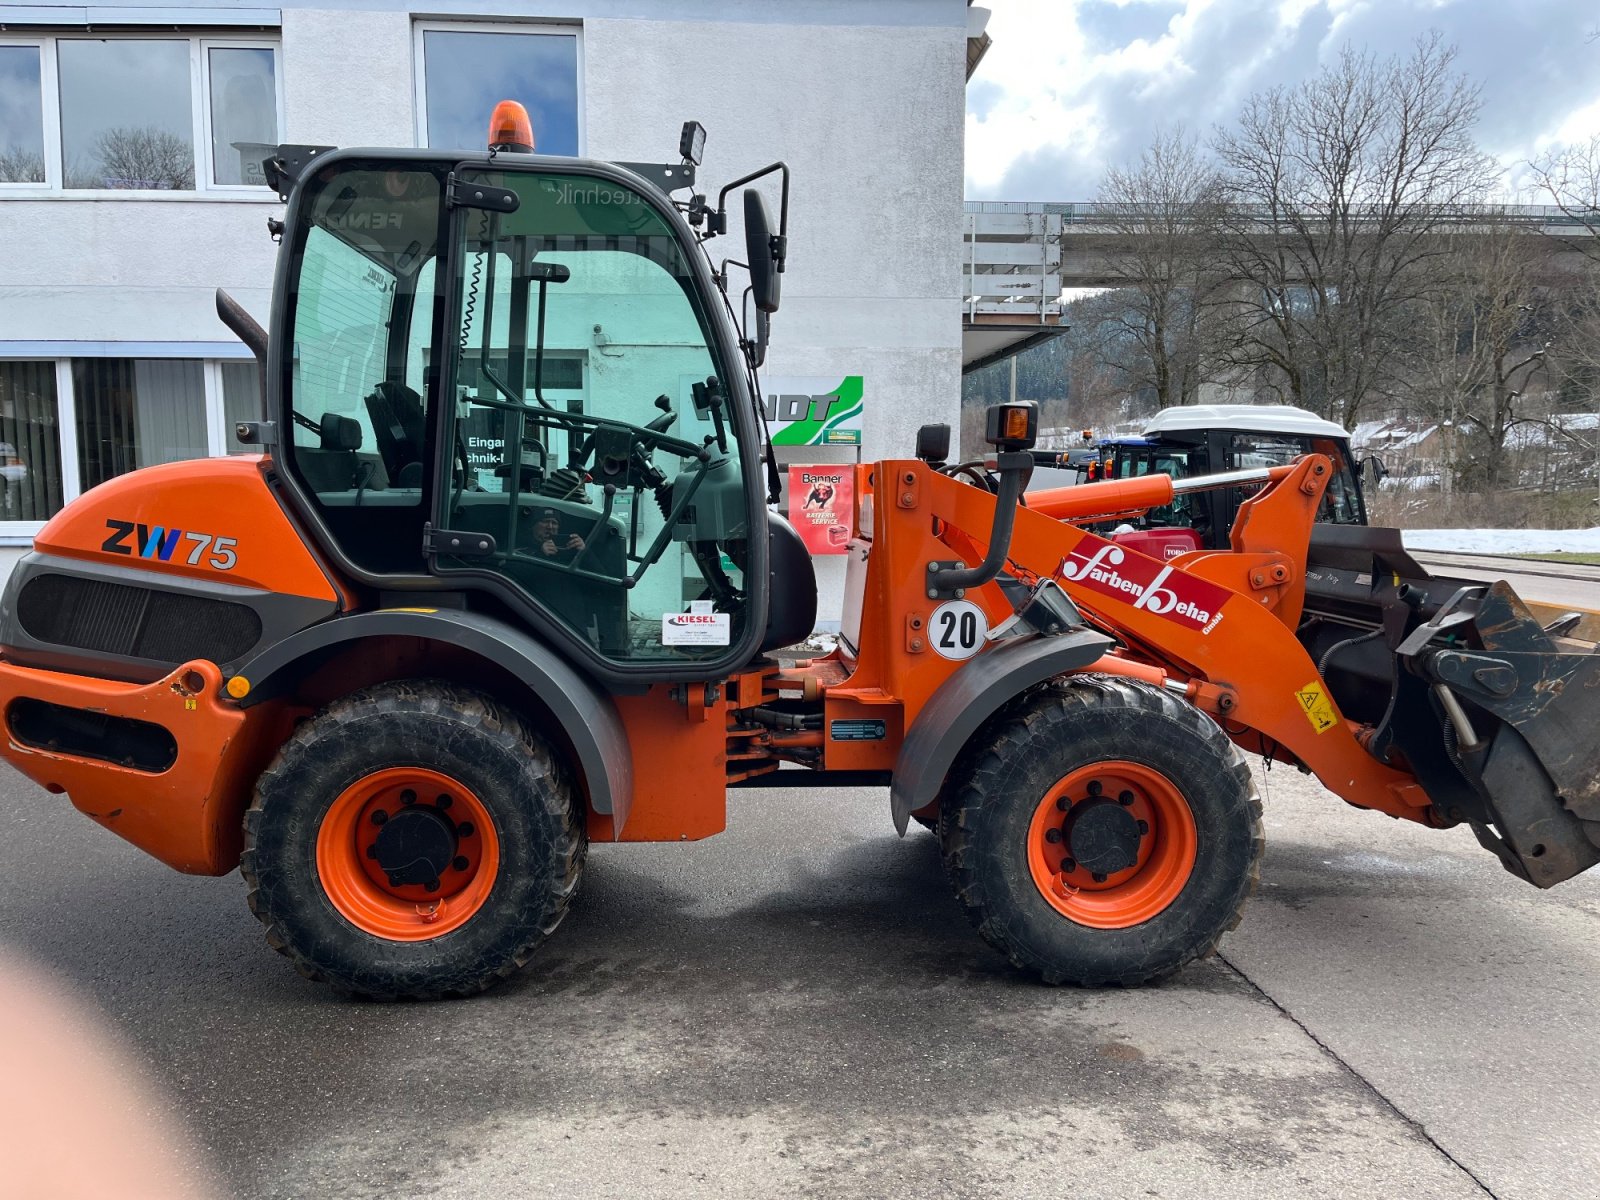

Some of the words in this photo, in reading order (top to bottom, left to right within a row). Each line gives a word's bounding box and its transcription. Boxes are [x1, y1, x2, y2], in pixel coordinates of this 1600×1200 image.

[689, 394, 840, 421] NDT
[802, 473, 842, 484] Banner
[677, 615, 716, 623] KIESEL
[939, 610, 977, 649] 20
[1202, 612, 1224, 636] GmbH
